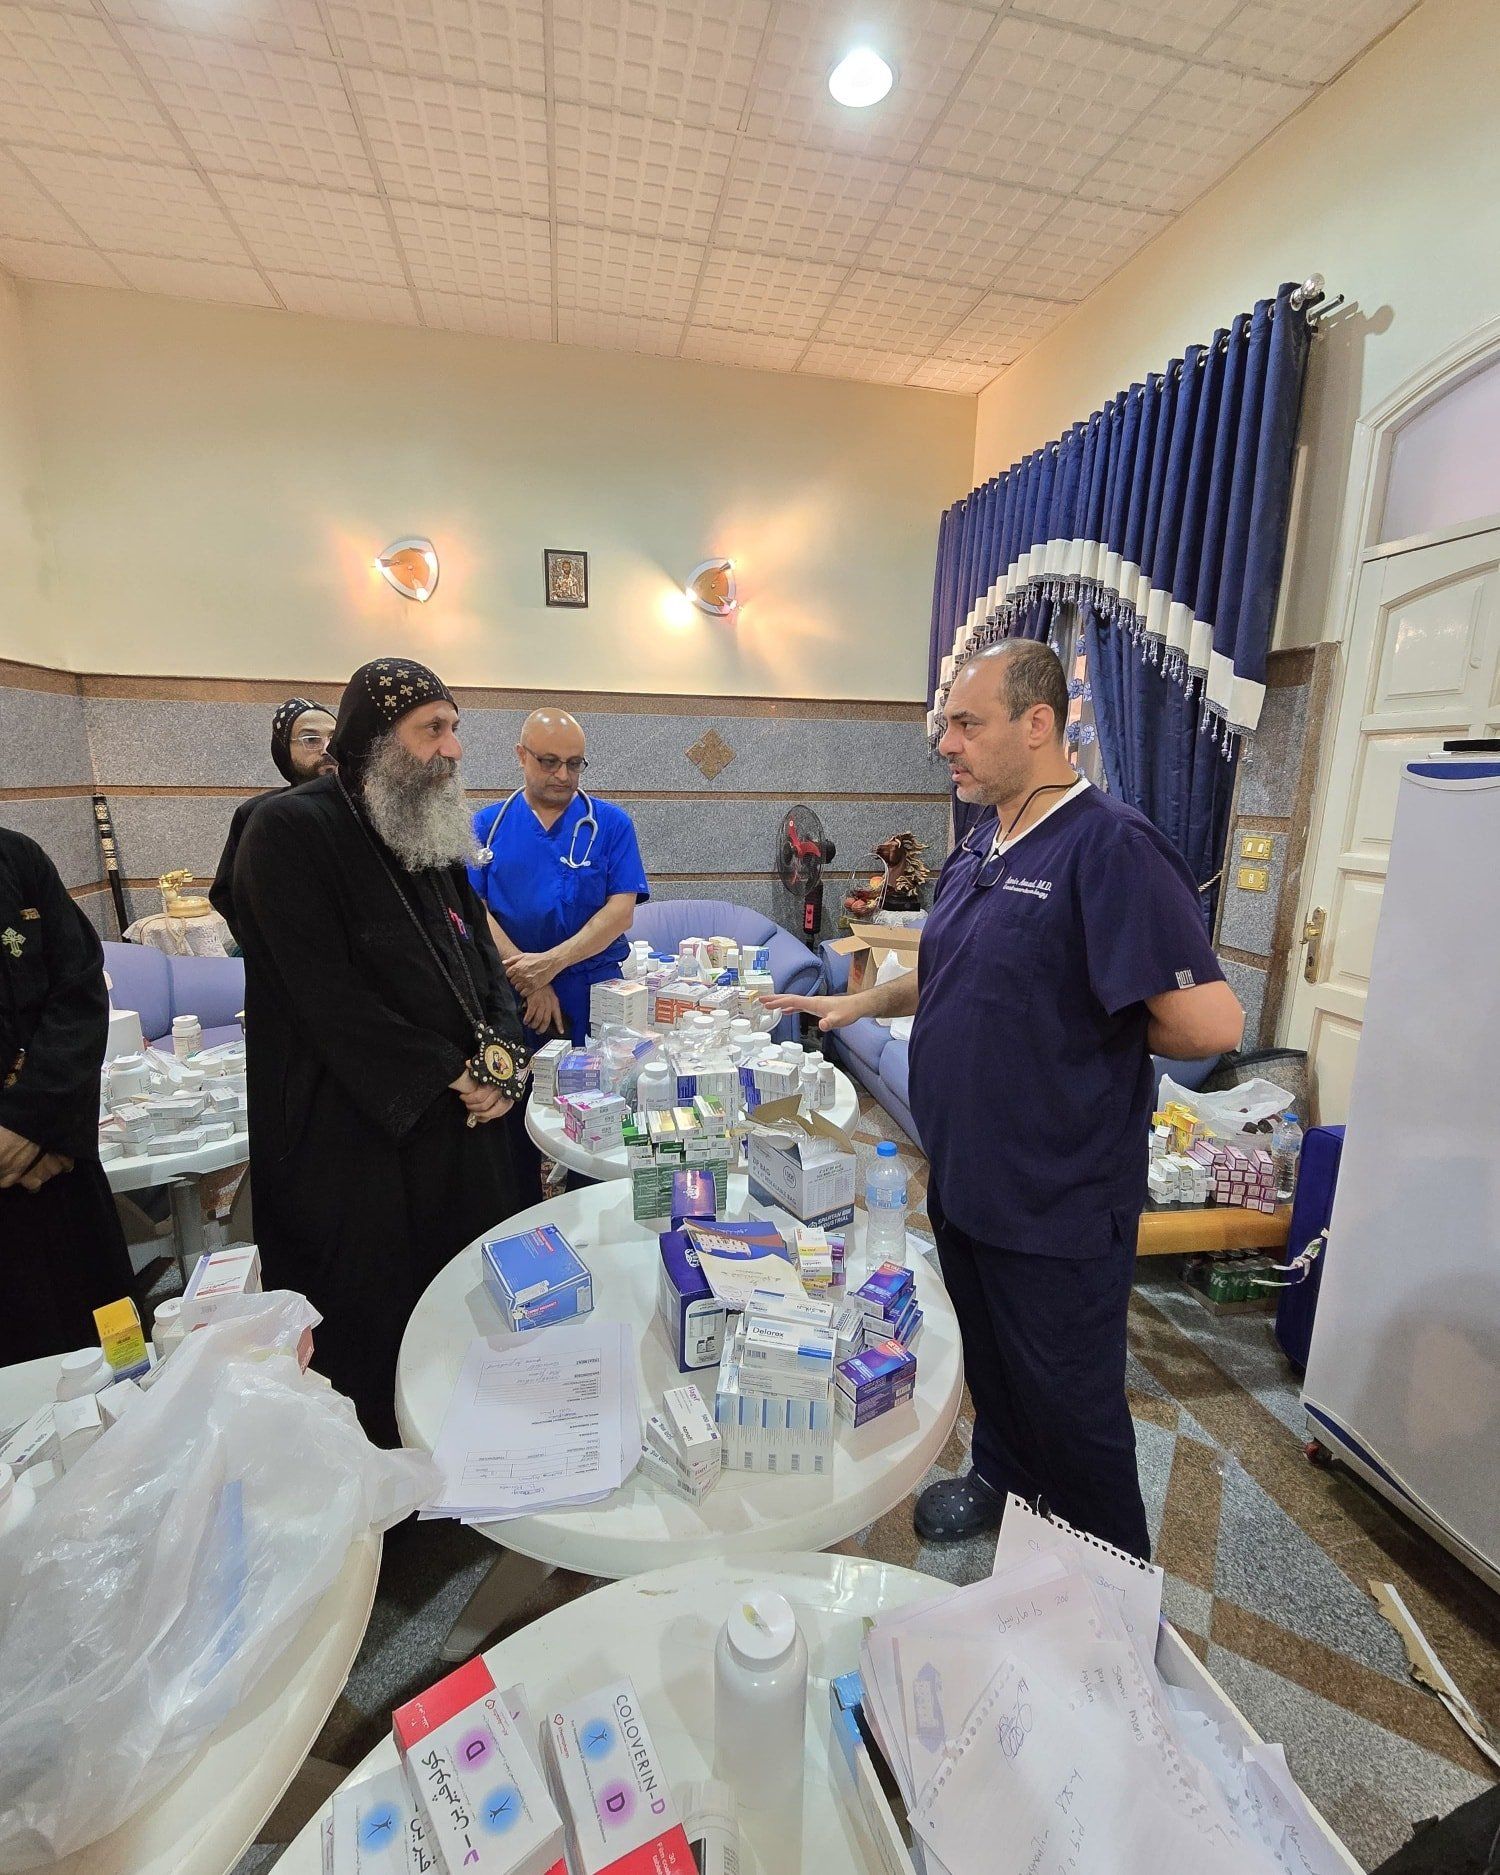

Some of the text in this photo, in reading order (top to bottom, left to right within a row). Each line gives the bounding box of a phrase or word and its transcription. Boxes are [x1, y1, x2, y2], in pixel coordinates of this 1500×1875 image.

[818, 1210, 842, 1224] SPARTAN
[752, 1327, 784, 1338] Delarex
[466, 1740, 485, 1761] D
[616, 1694, 666, 1814] COLOVERIN-D
[606, 1792, 625, 1812] D
